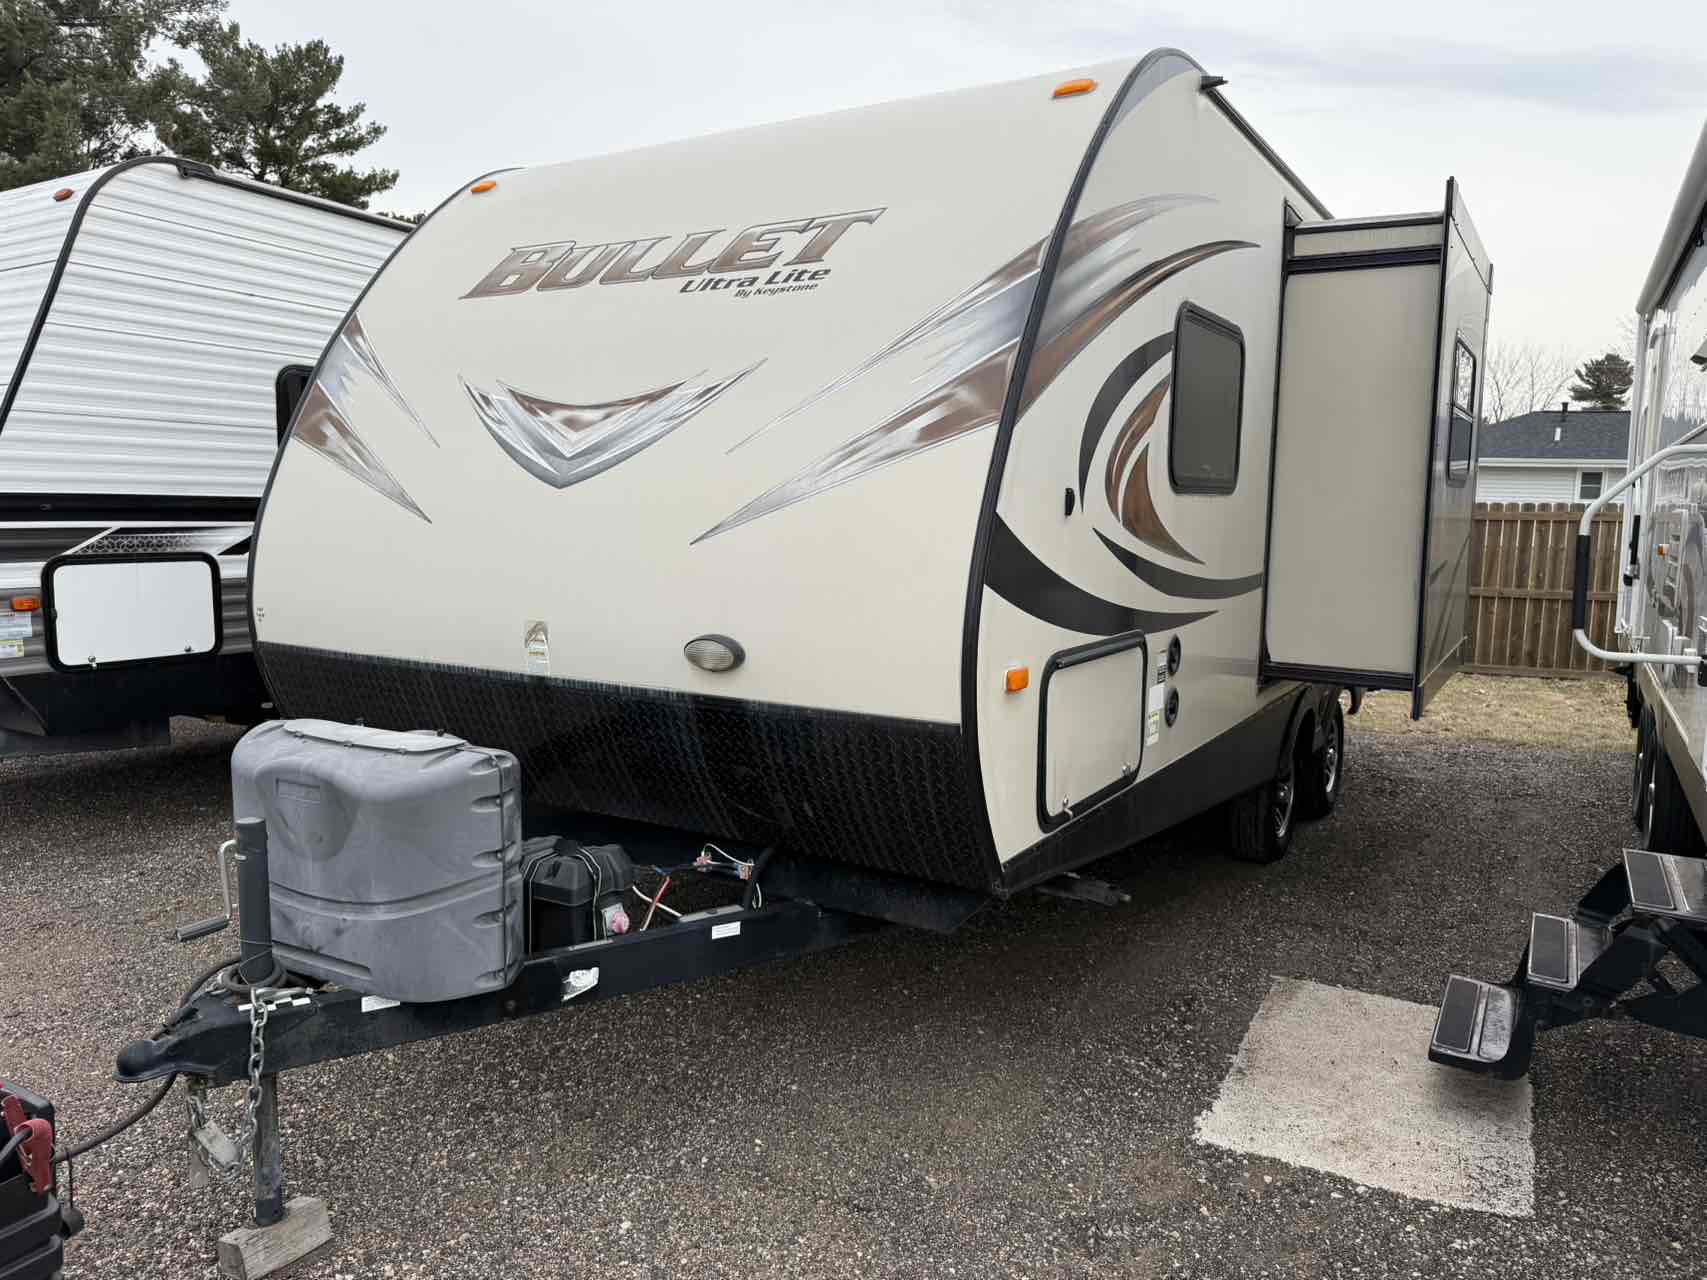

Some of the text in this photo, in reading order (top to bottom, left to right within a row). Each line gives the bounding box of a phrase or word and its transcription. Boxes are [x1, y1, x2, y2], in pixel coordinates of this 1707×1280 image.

[457, 207, 888, 299] BULLET
[679, 266, 832, 294] Ultra Lite
[734, 283, 819, 299] By Keystone
